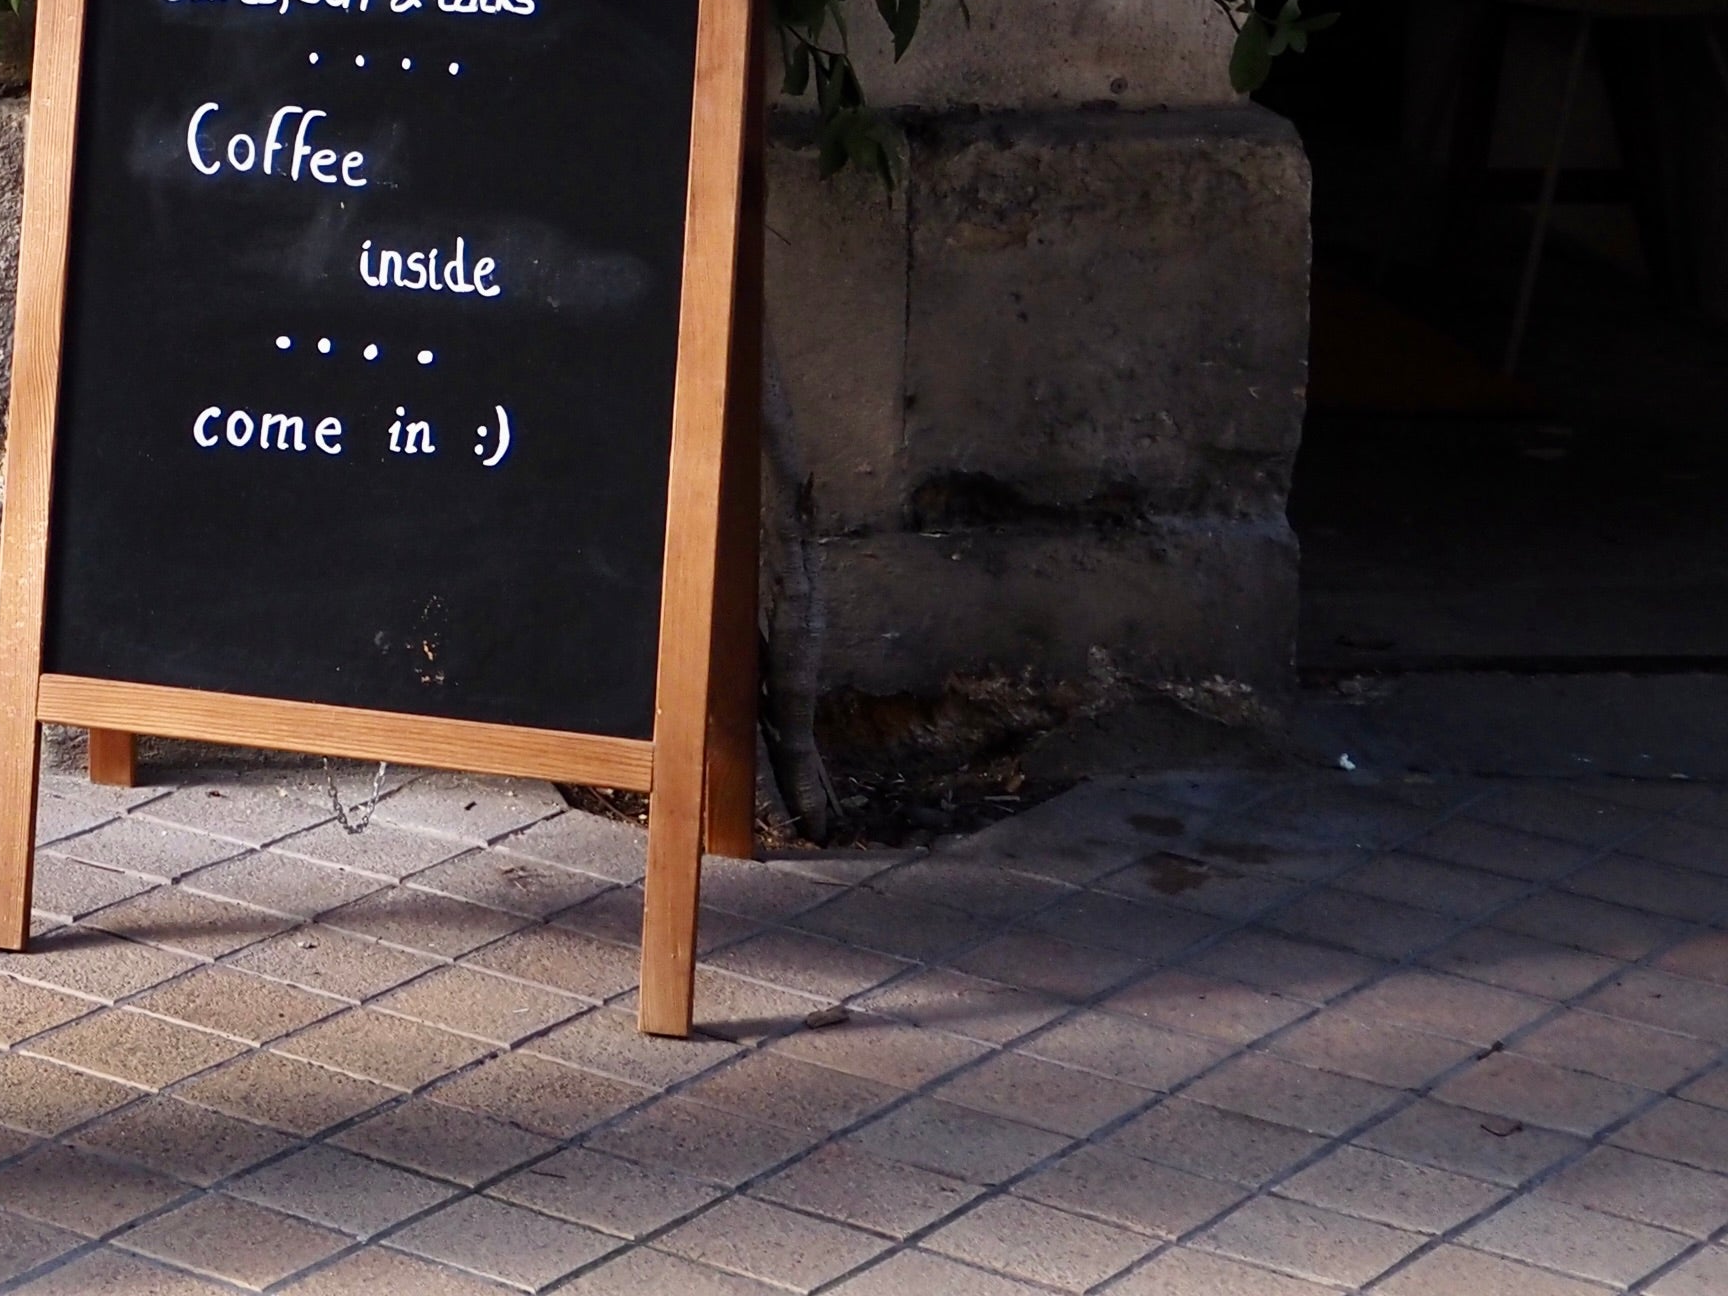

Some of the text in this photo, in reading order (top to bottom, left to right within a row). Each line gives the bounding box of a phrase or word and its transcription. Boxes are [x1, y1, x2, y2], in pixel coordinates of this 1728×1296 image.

[186, 101, 368, 188] Coffee
[359, 236, 501, 298] inside
[192, 404, 512, 468] come in :)
